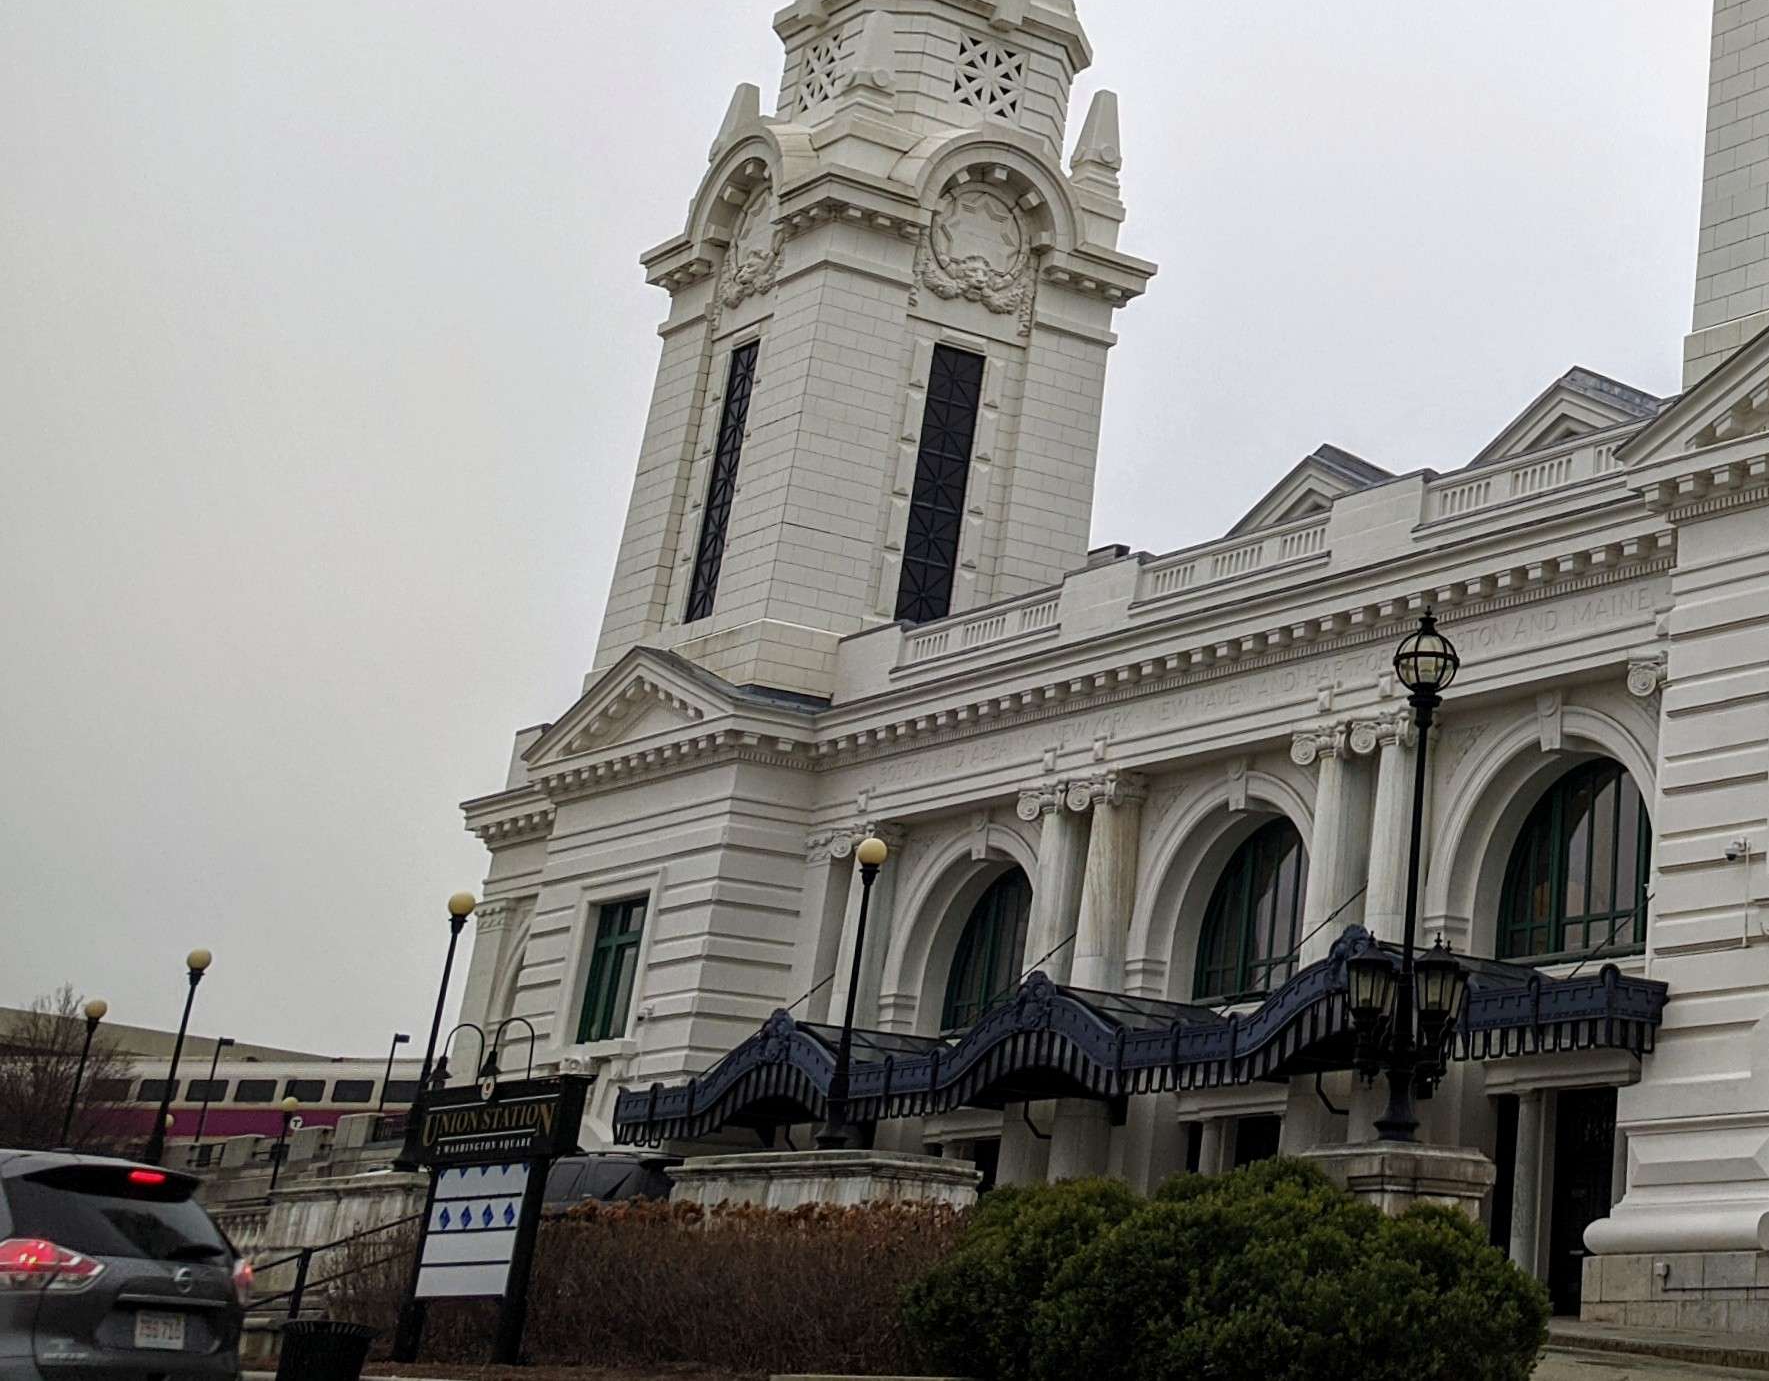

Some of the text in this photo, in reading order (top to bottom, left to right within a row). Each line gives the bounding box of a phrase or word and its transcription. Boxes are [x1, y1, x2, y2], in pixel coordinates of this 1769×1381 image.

[1194, 682, 1250, 713] HAVEN
[1257, 670, 1296, 698] AND
[1513, 609, 1559, 641] AND
[1571, 588, 1650, 627] MAINE
[422, 1102, 557, 1147] UNION STATION
[444, 1140, 497, 1153] WASHINGTON
[499, 1136, 532, 1151] SQUARE
